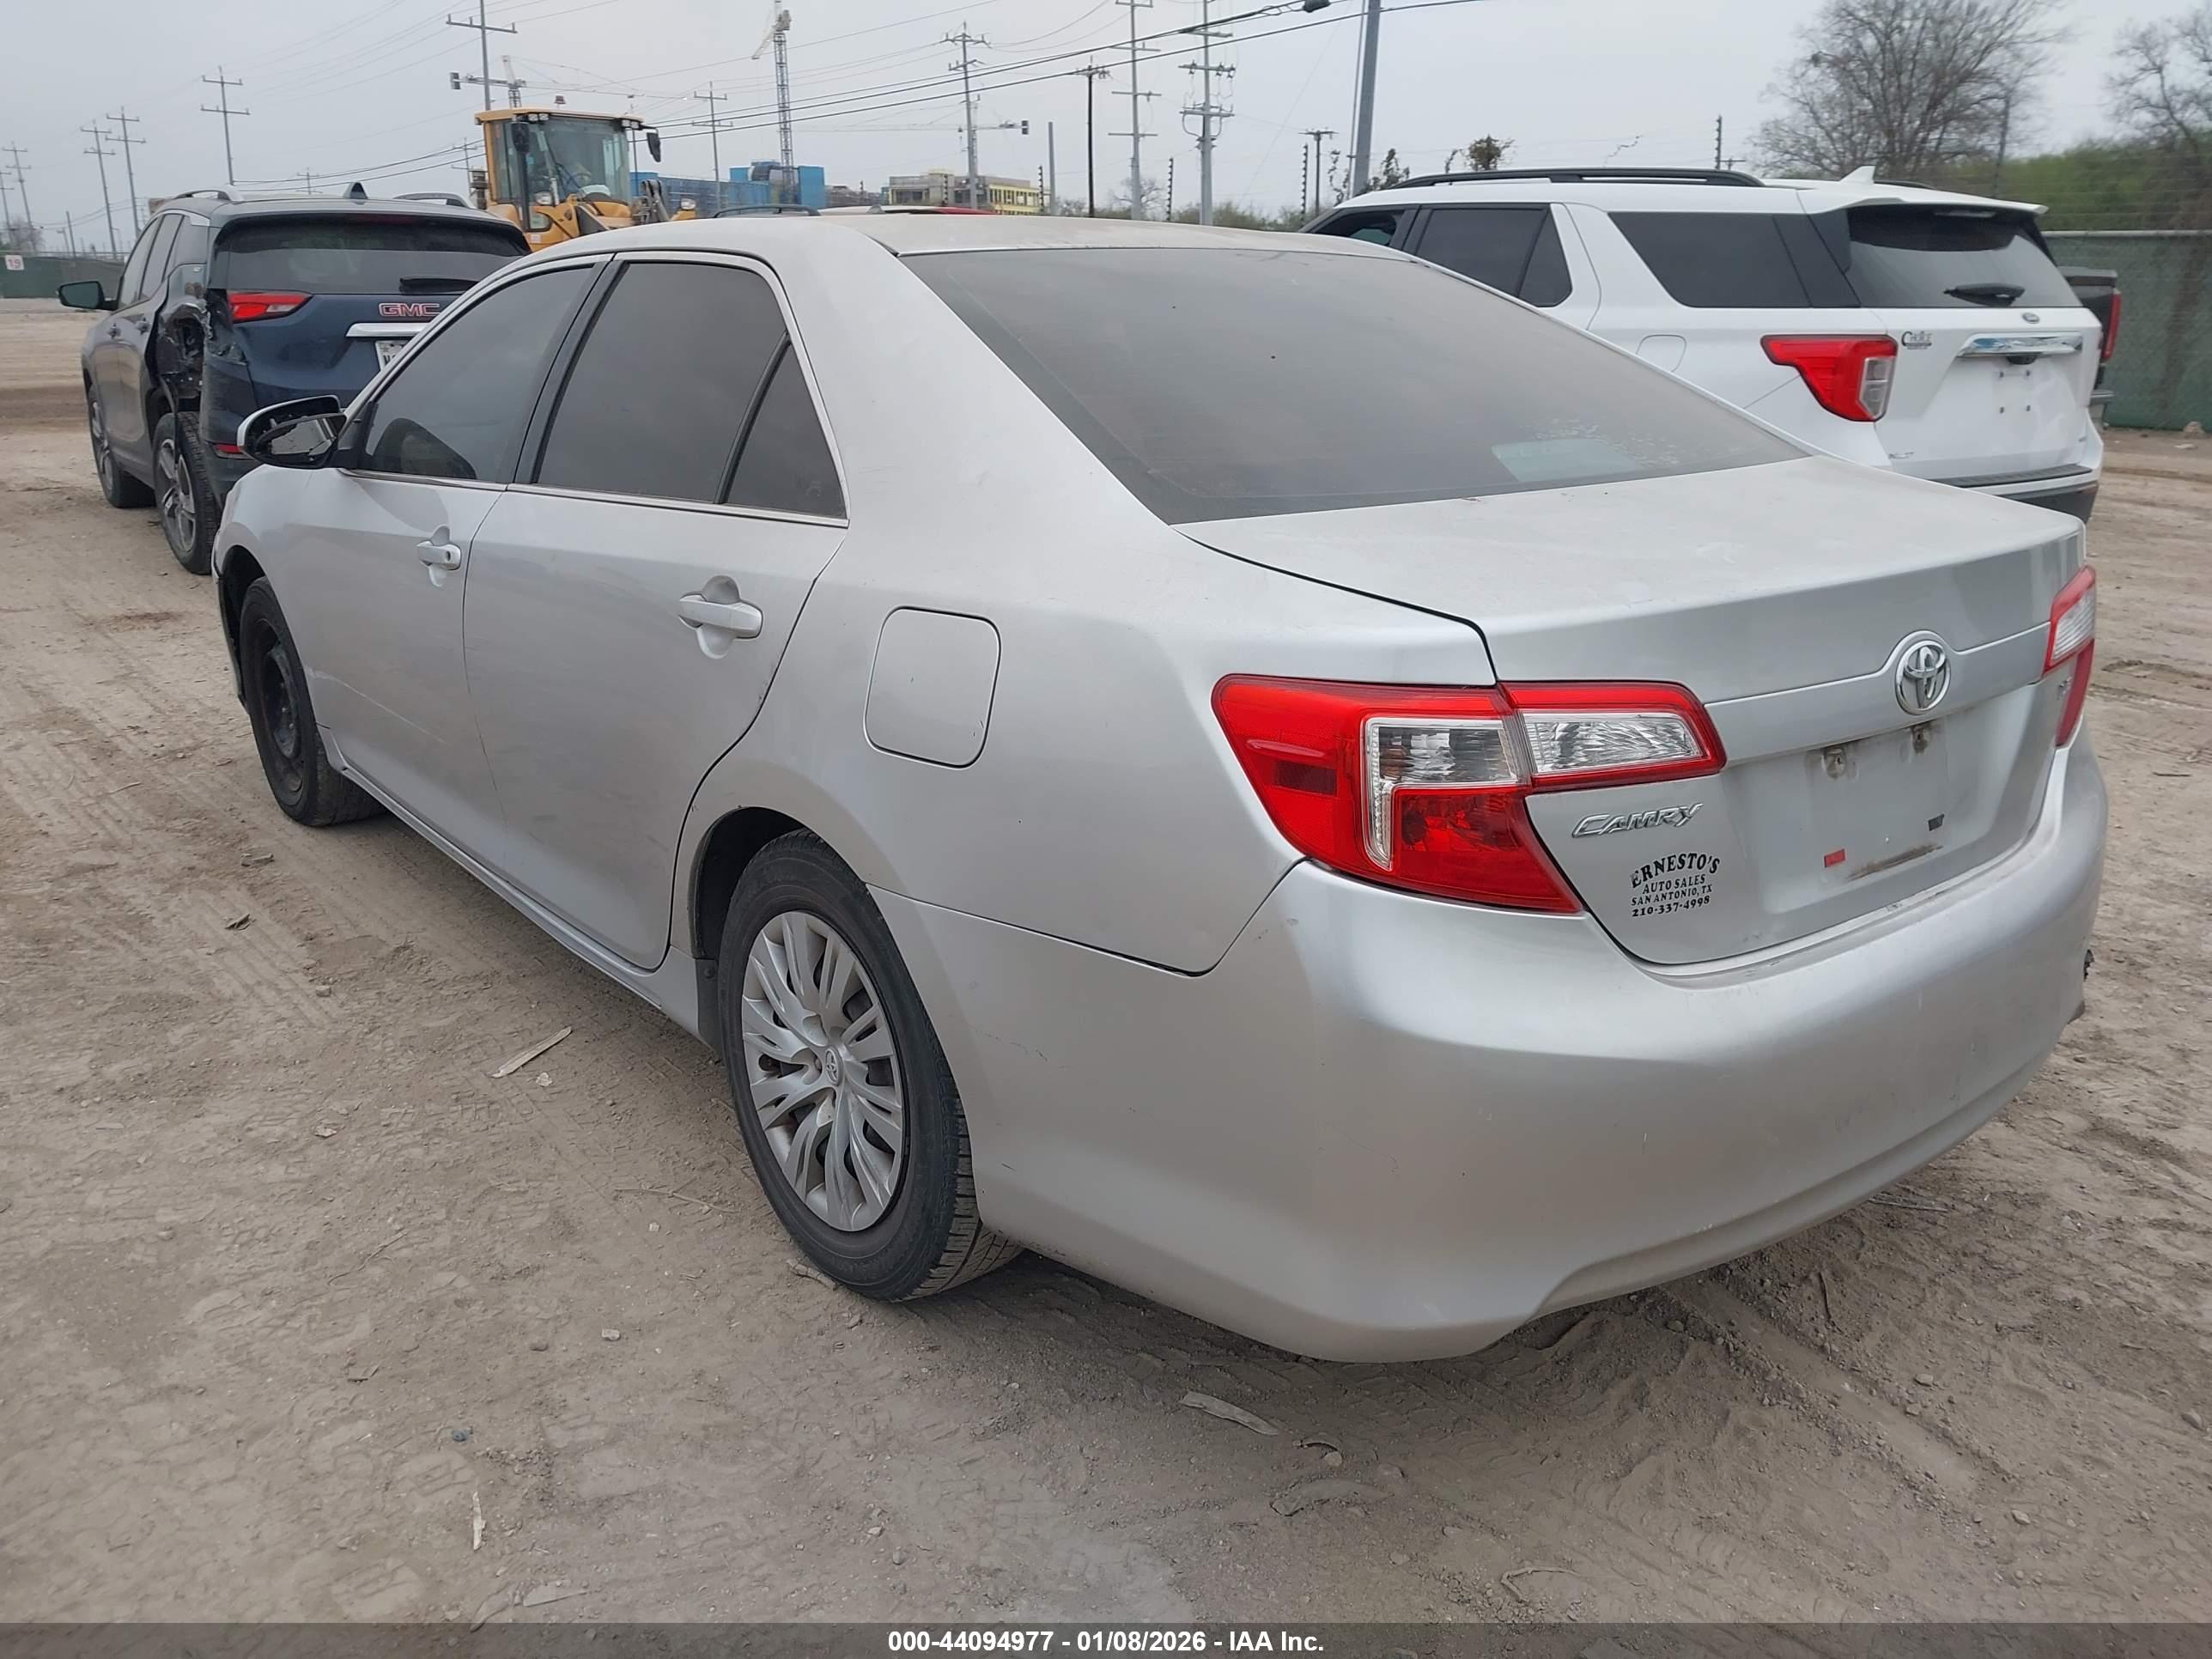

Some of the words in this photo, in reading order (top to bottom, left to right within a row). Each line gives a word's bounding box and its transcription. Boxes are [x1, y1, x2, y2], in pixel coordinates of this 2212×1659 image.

[379, 302, 441, 317] GMC
[1572, 803, 1704, 838] CAMRY
[1630, 853, 1720, 889] ERNESTO'S
[1642, 879, 1672, 894] AUTO
[1674, 873, 1706, 890] SALES
[1631, 895, 1651, 907] SAN
[1653, 887, 1700, 903] ANTONIO,
[1701, 884, 1713, 895] TX
[1631, 895, 1711, 917] 210-337-4998
